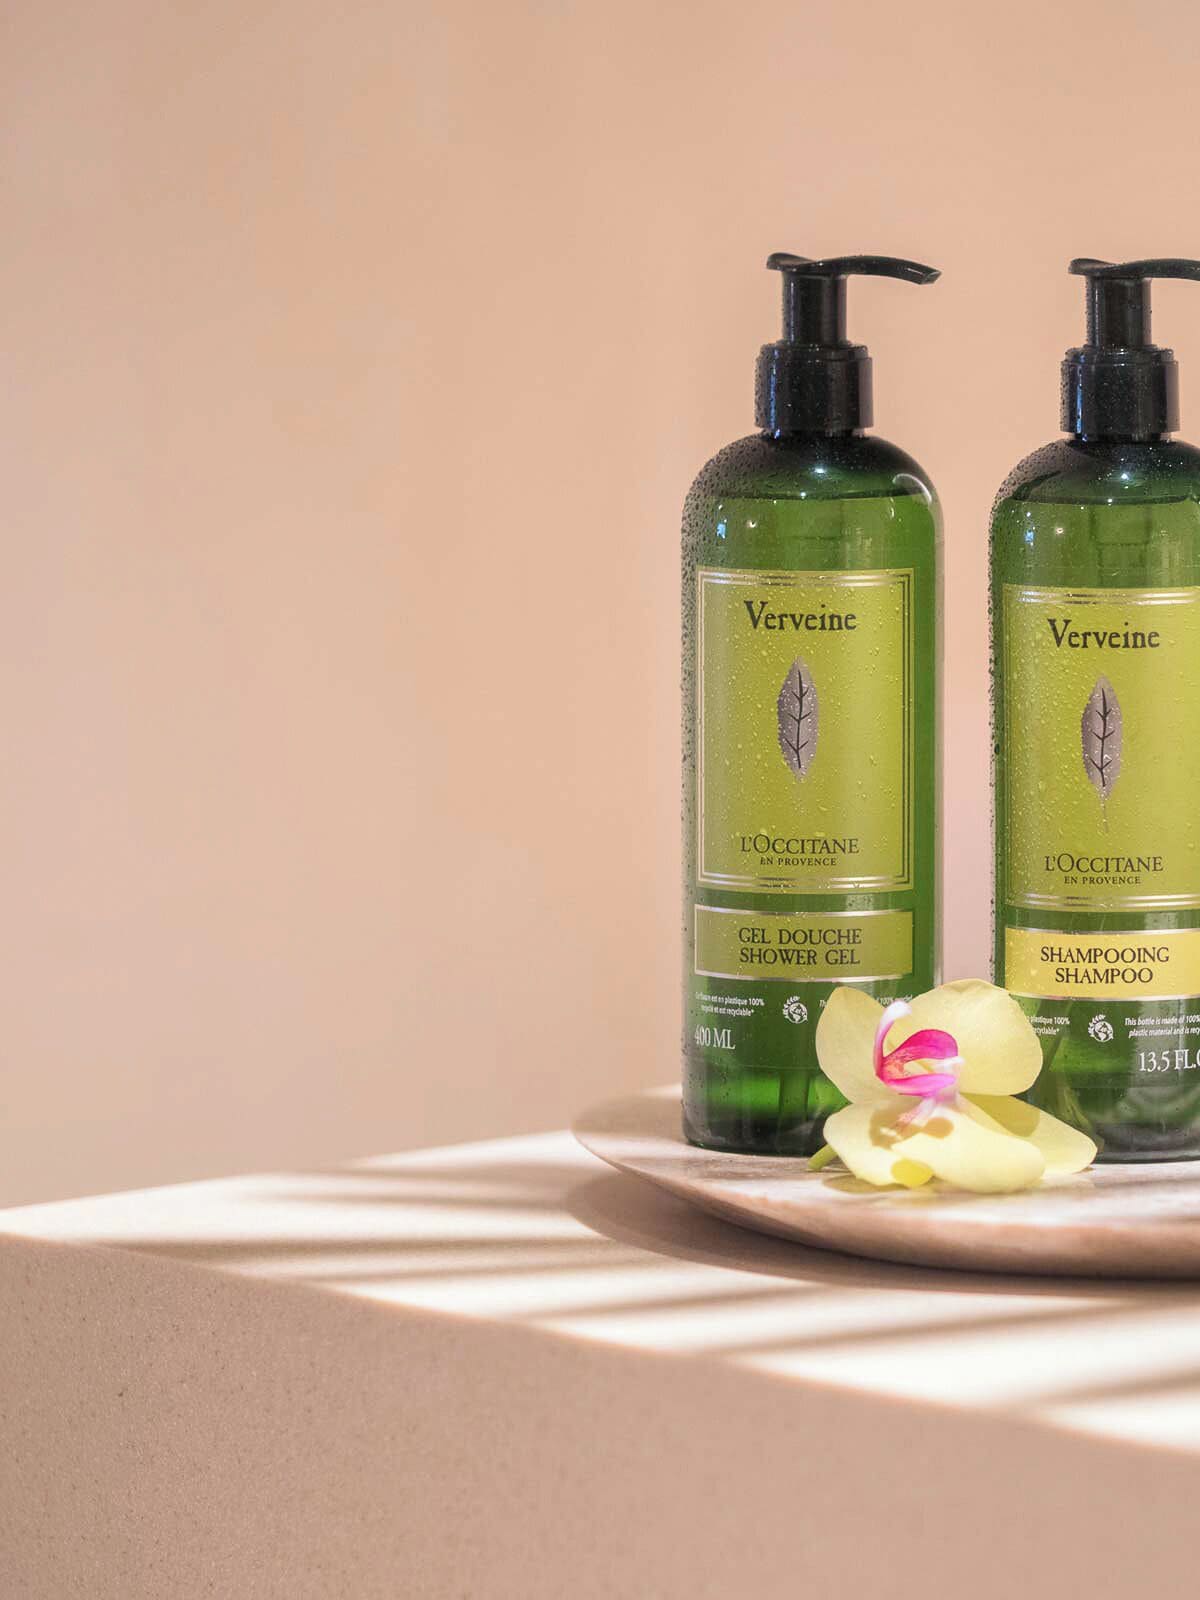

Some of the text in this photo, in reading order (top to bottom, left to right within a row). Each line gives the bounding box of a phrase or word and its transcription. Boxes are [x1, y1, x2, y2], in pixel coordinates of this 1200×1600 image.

[743, 600, 857, 630] Verveine
[1047, 618, 1160, 649] Verveine
[760, 857, 837, 866] EN PROVENCE
[1064, 876, 1141, 885] EN PROVENCE
[739, 927, 862, 945] GEL DOUCHE
[740, 948, 860, 965] SHOWER GEL
[1040, 947, 1169, 964] SHAMPOOING
[1055, 968, 1153, 984] SHAMPOO
[749, 998, 765, 1006] 100%
[1054, 1016, 1070, 1025] 100%
[1125, 1017, 1137, 1026] This
[1137, 1017, 1155, 1025] bottle
[1161, 1016, 1178, 1025] made
[1186, 1014, 1200, 1023] 100%
[695, 1024, 736, 1050] 400 ML
[1128, 1028, 1149, 1039] plastic
[1149, 1027, 1173, 1037] material
[1173, 1027, 1184, 1035] and
[1139, 1050, 1170, 1072] 13.5
